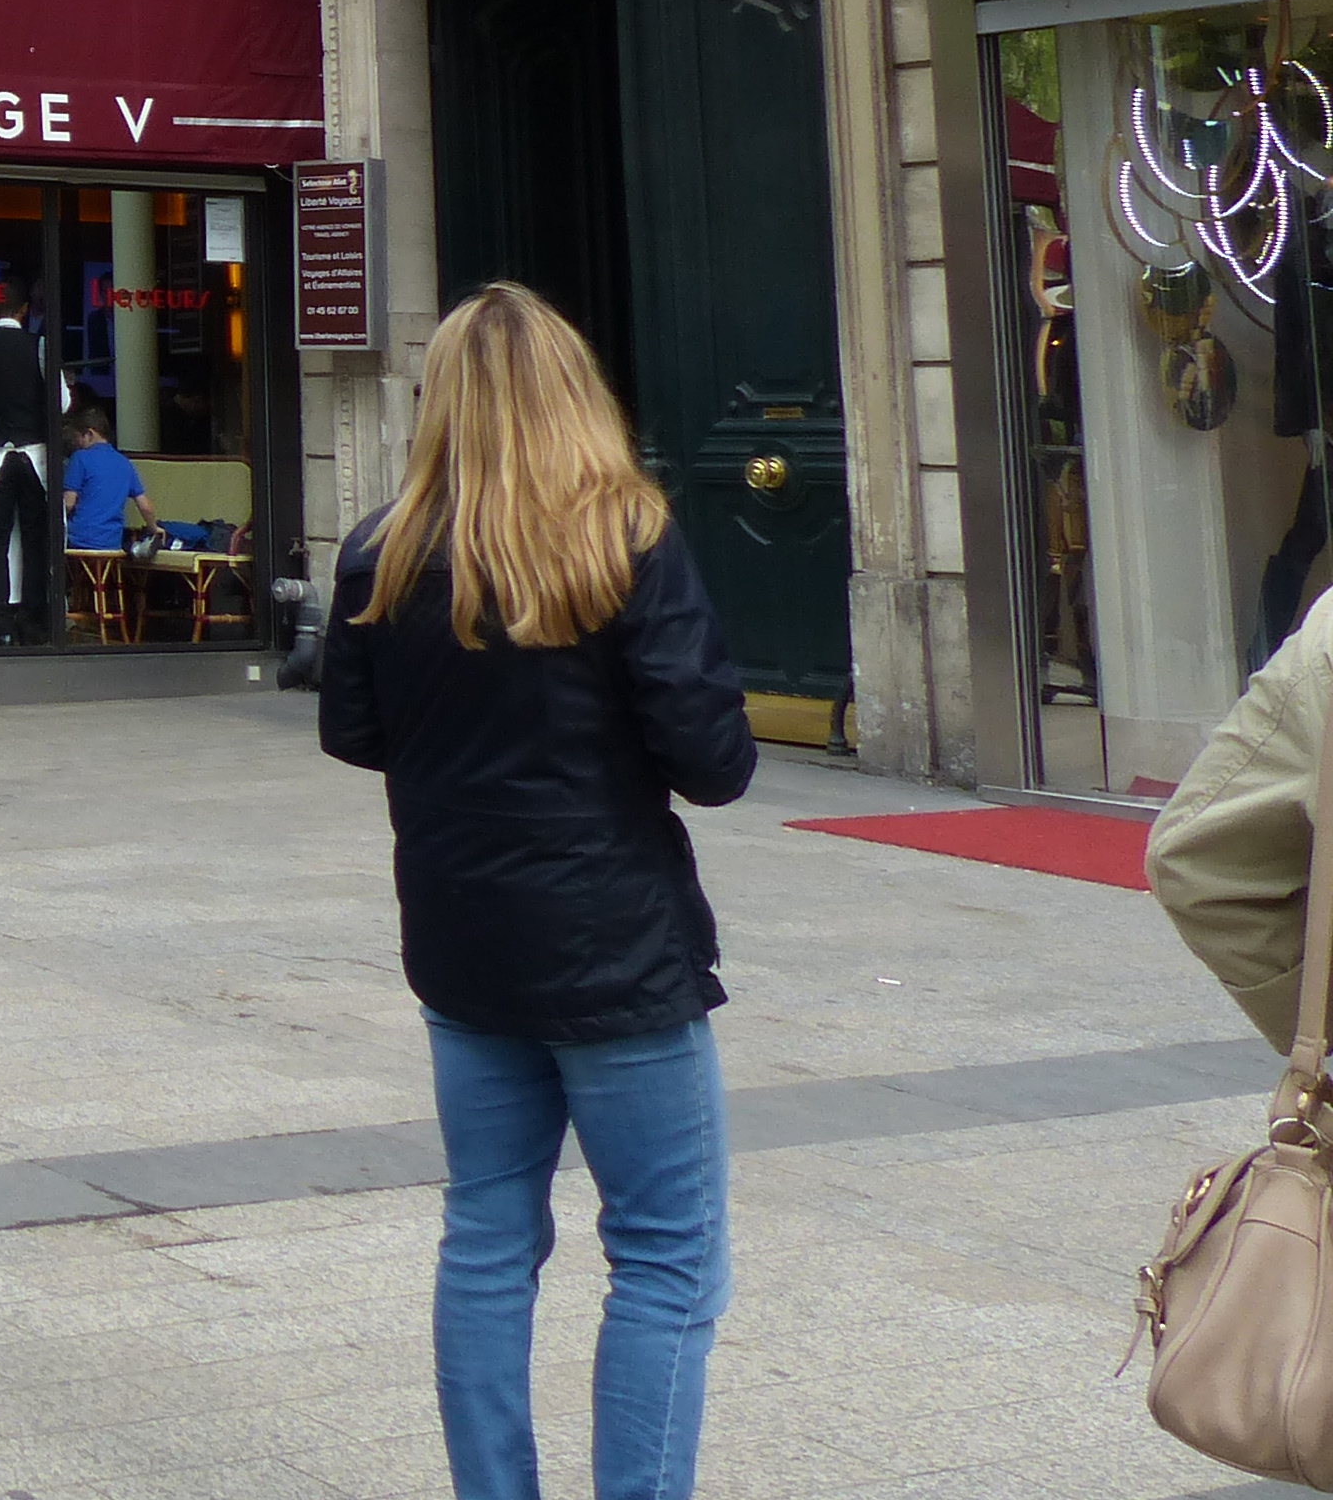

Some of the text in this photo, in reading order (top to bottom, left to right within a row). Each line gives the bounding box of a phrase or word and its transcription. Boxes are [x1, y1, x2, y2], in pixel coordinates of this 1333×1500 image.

[115, 96, 154, 143] V
[328, 196, 363, 208] Voyages
[332, 252, 340, 260] et
[304, 281, 312, 290] et
[90, 278, 212, 313] LIQUEURS
